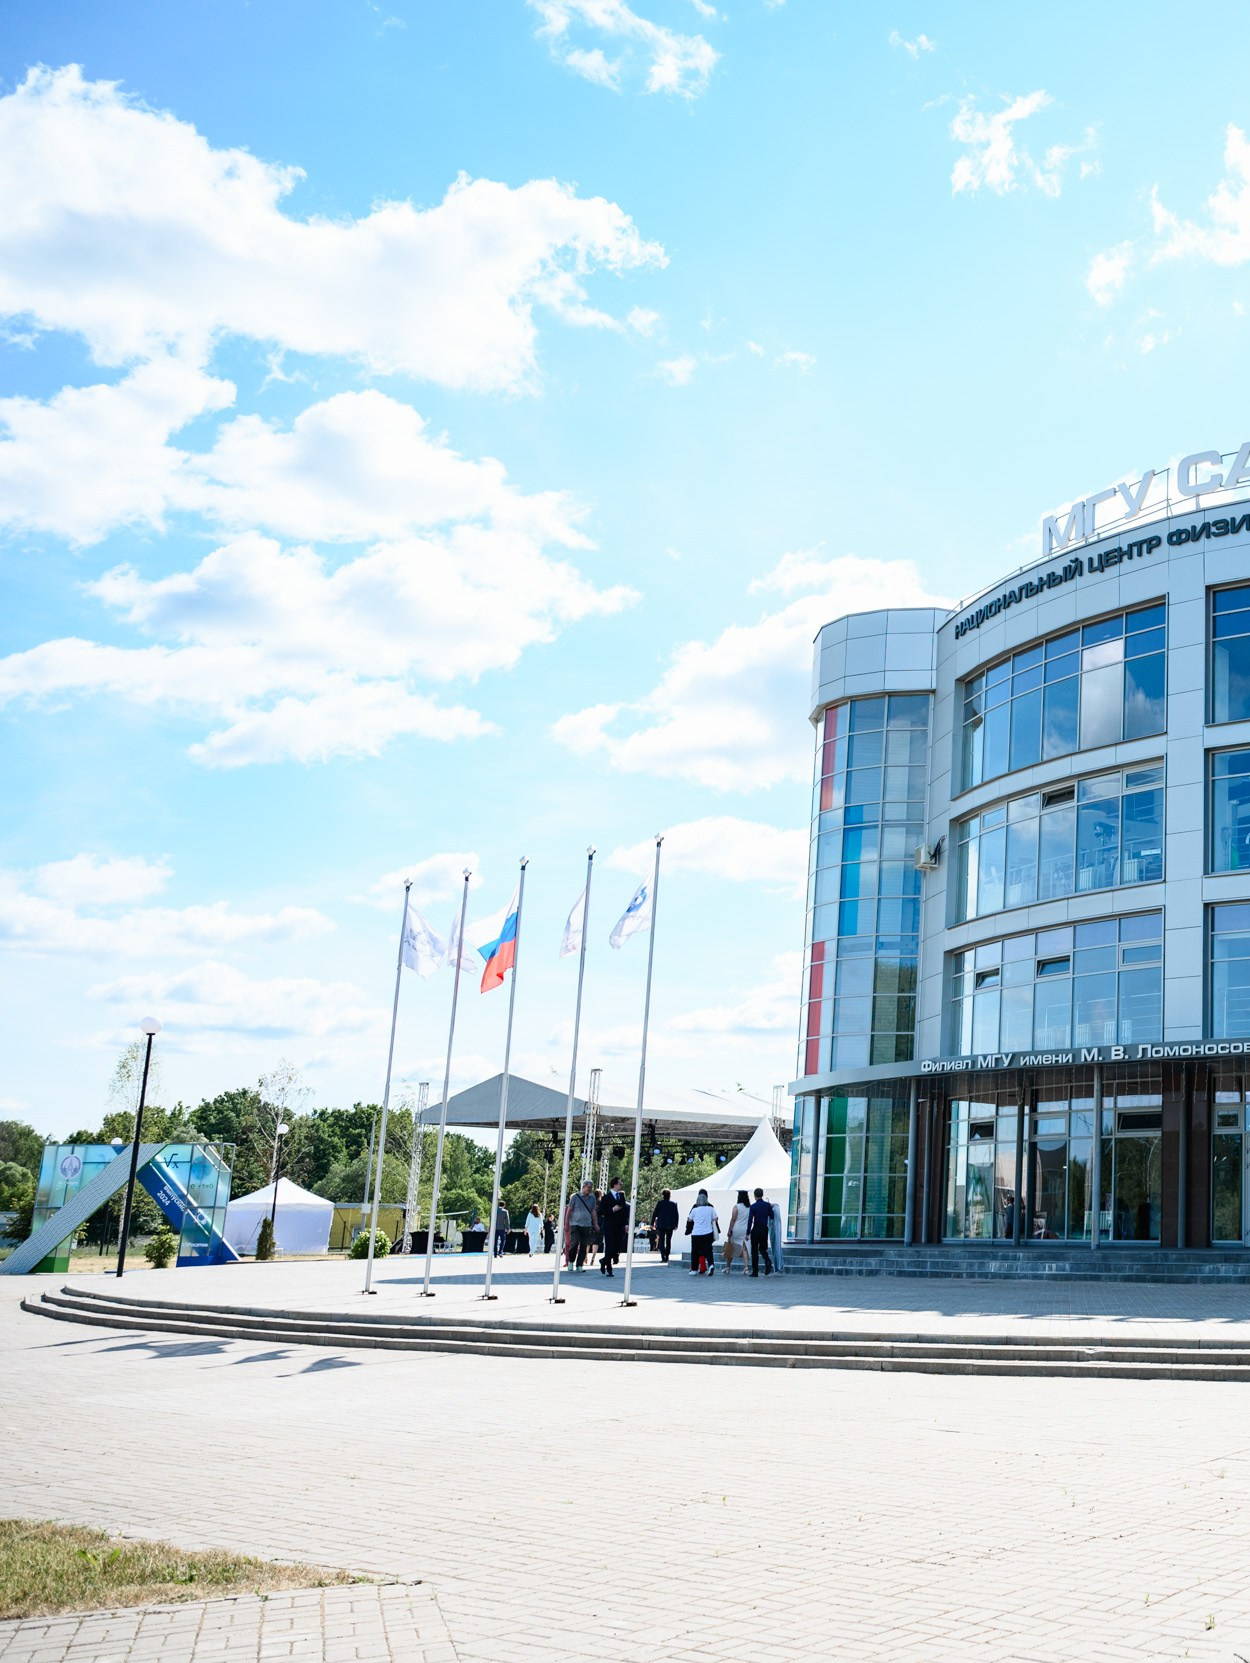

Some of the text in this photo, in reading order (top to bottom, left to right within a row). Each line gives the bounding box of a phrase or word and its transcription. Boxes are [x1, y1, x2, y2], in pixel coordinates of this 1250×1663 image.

[1042, 469, 1156, 557] МГУ
[955, 557, 1083, 640] НАЦИОНАЛЬНЫЙ
[1087, 535, 1161, 574] ЦЕНТР
[921, 1059, 972, 1073] Филиал
[977, 1053, 1013, 1069] МГУ
[1020, 1052, 1073, 1066] имени
[1080, 1047, 1103, 1062] М.
[1110, 1046, 1129, 1060] В.
[157, 1190, 171, 1207] 2024
